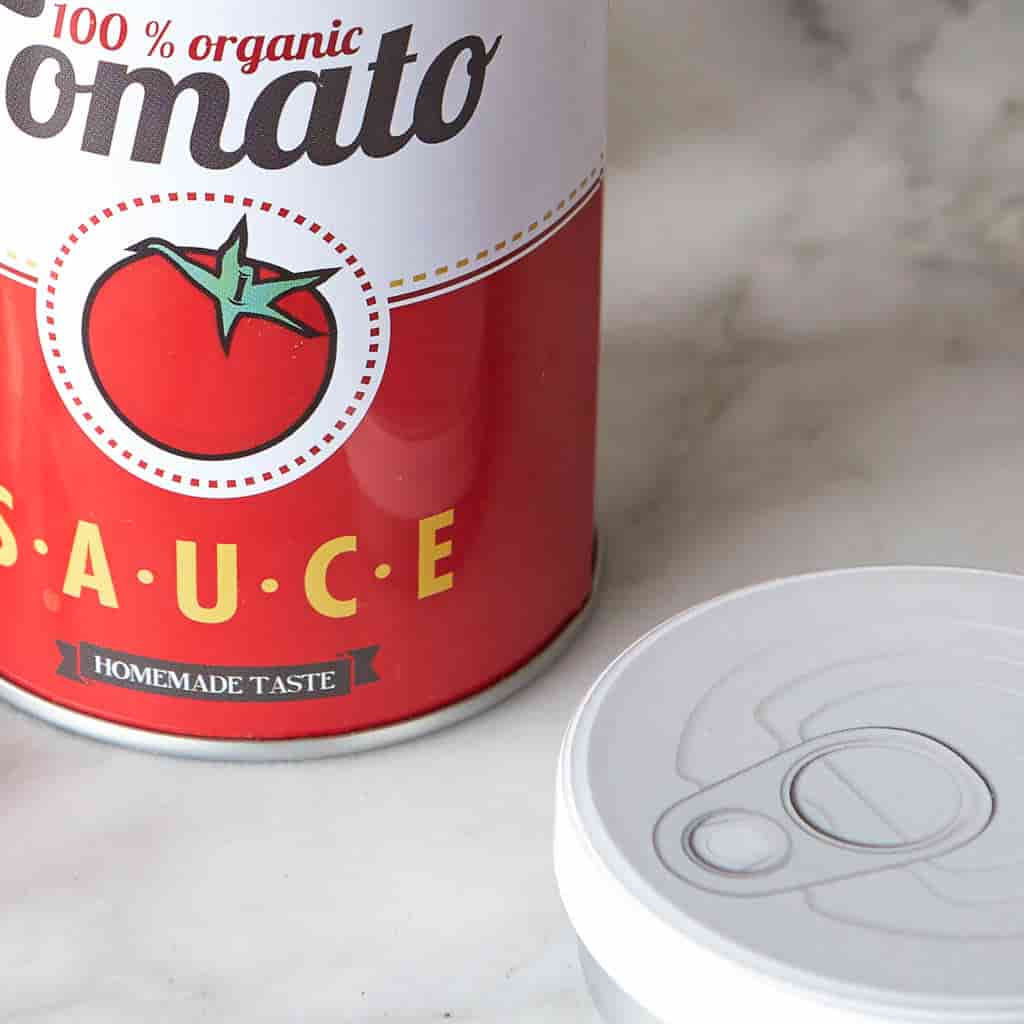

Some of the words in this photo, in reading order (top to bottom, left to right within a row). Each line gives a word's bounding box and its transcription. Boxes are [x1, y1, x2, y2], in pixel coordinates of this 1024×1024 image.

[51, 2, 129, 52] 100
[145, 19, 176, 59] %
[187, 19, 364, 74] organic
[93, 655, 244, 696] HOMEMADE
[249, 670, 337, 696] TASTE
